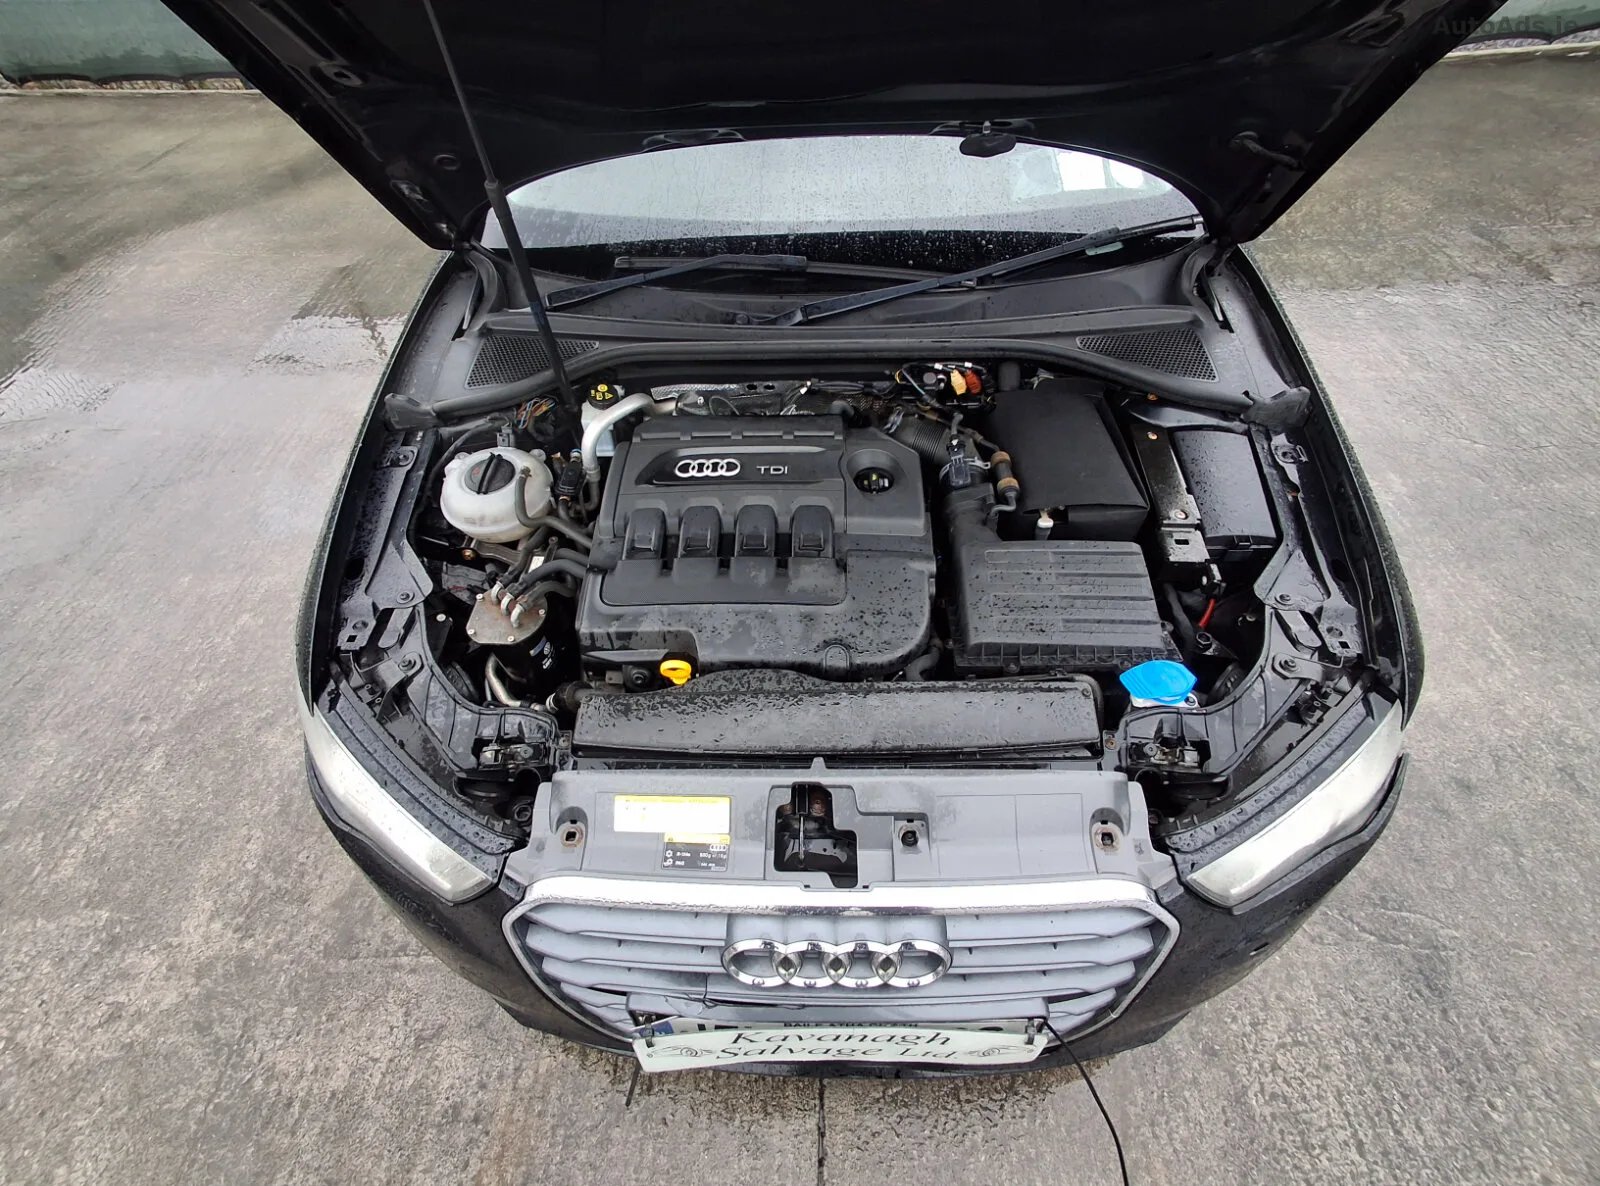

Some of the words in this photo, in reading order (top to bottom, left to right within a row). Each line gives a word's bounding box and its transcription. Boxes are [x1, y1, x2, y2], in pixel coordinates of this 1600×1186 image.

[755, 465, 788, 475] TDI
[731, 1031, 951, 1046] Kavanagh
[715, 1044, 883, 1058] Salvage
[898, 1047, 958, 1060] Ltd.
